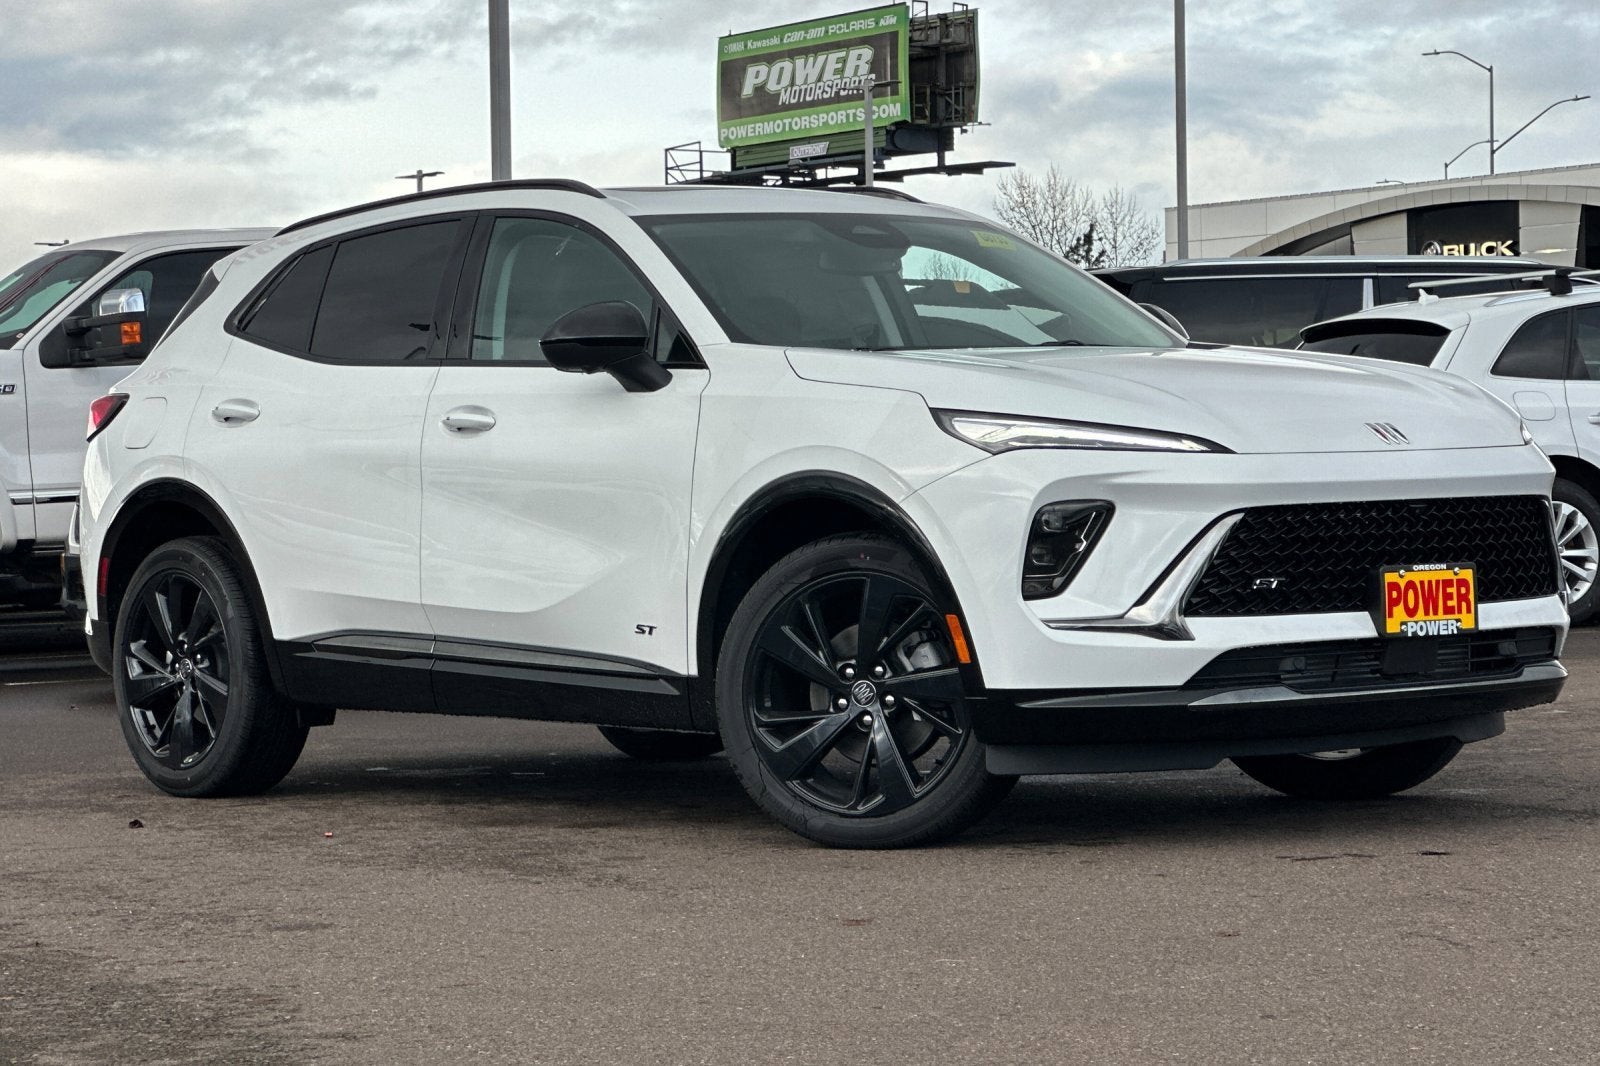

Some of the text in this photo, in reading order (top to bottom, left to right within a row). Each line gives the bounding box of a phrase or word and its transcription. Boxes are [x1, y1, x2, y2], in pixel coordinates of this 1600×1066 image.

[747, 35, 780, 50] Kawasaki
[828, 18, 875, 35] POLARIS
[879, 15, 897, 27] KTM
[742, 46, 873, 97] POWER
[720, 102, 901, 141] POWERMOTORSPORTSCOM
[1443, 240, 1514, 256] BUICK
[1386, 578, 1472, 618] POWER
[634, 624, 657, 636] ST
[1407, 620, 1458, 636] POWER
